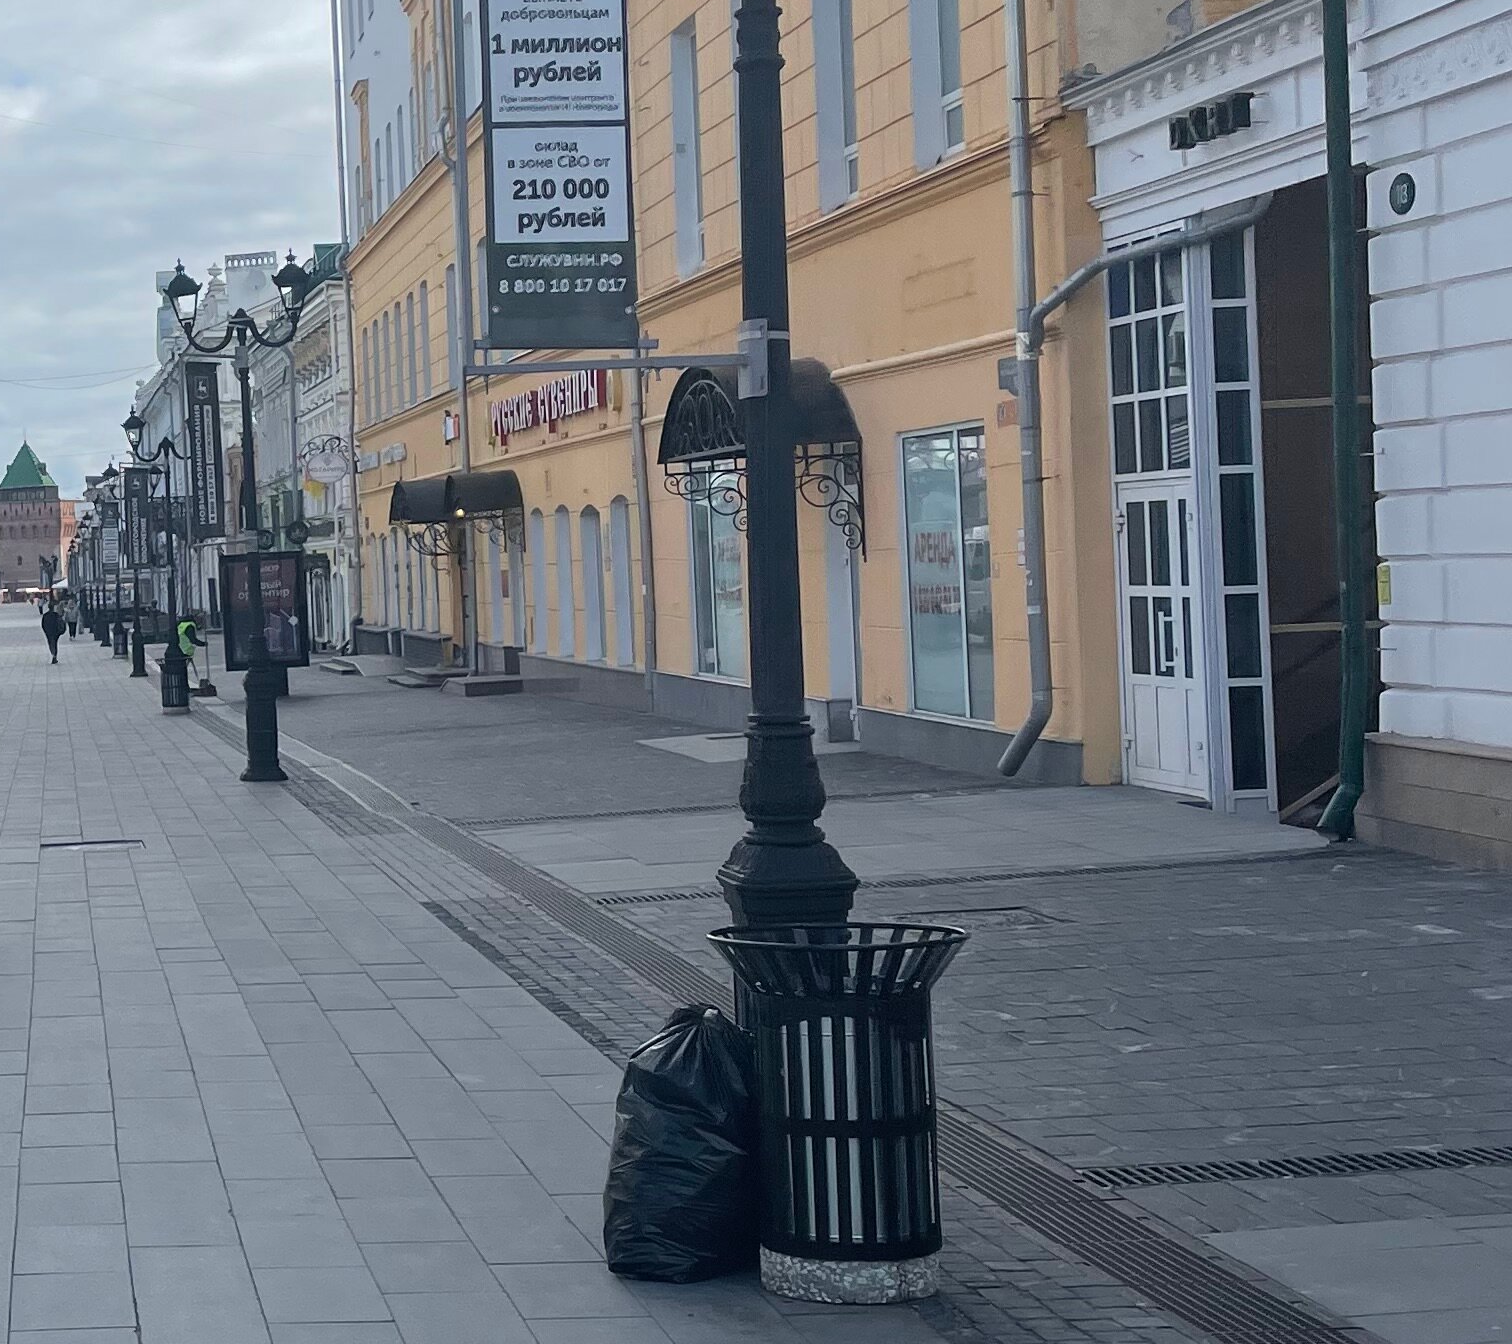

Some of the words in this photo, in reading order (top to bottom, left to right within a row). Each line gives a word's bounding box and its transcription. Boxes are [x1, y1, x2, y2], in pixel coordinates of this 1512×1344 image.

[500, 6, 609, 22] добровольцам
[491, 33, 506, 54] 1
[511, 37, 622, 54] миллион
[513, 60, 602, 88] рублей
[534, 141, 578, 153] оклад
[507, 159, 515, 169] в
[519, 159, 553, 168] зоне
[557, 155, 590, 168] СВО
[593, 157, 611, 168] от
[512, 178, 556, 200] 210
[563, 178, 610, 199] 000
[518, 207, 606, 233] рублей
[499, 279, 509, 293] 8
[513, 279, 545, 293] 800
[550, 279, 570, 292] 10
[575, 278, 593, 292] 17
[597, 278, 626, 292] 017
[914, 532, 956, 567] АРЕНДА
